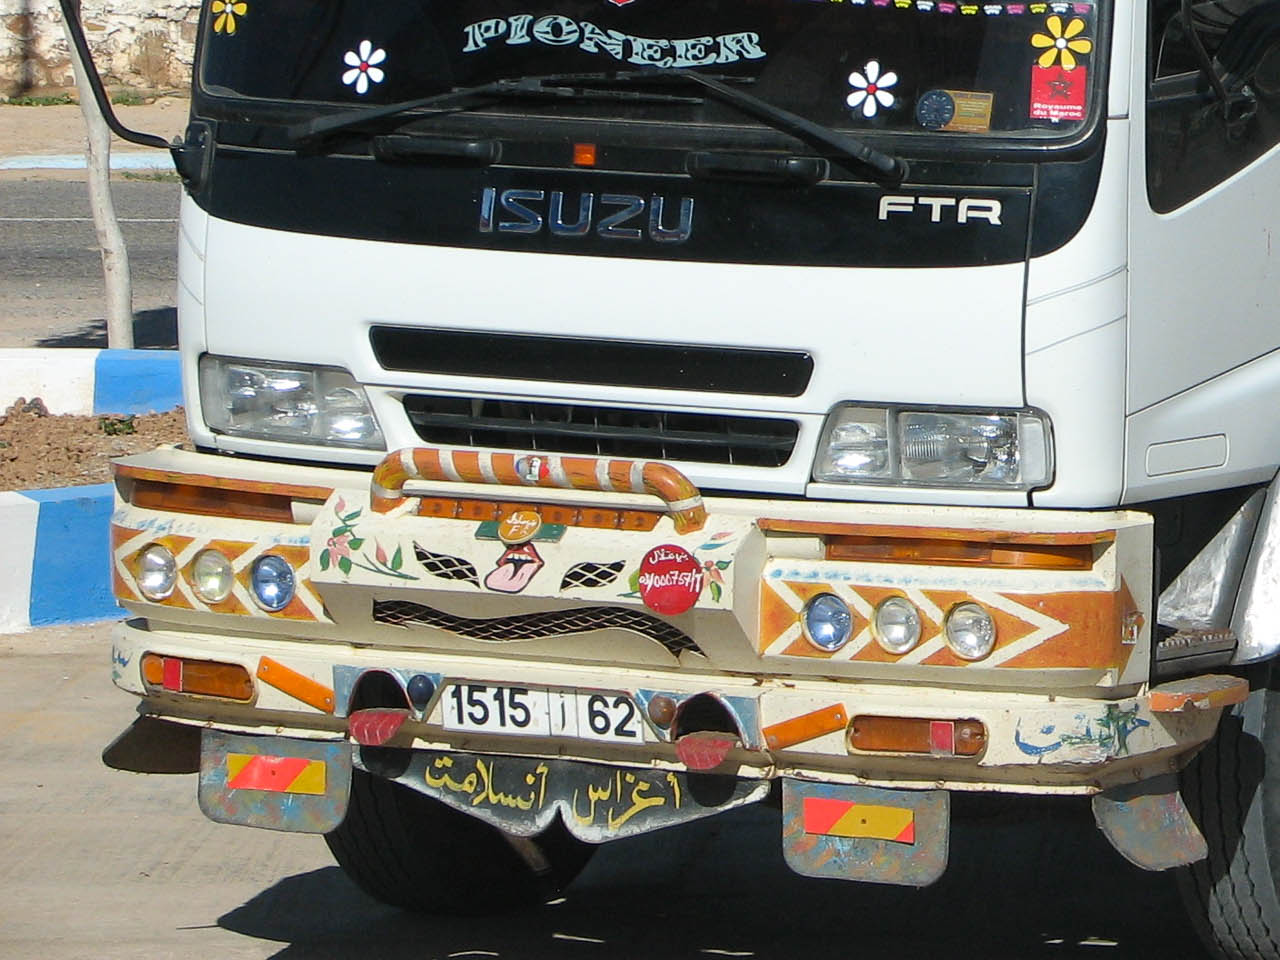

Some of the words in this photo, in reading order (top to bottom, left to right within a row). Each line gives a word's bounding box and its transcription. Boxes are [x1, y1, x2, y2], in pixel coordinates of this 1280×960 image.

[462, 14, 767, 69] PIONEER
[1033, 102, 1083, 111] Royaume
[1049, 109, 1082, 117] Maroc
[478, 187, 695, 244] ISUZU
[877, 195, 1003, 226] FTR
[450, 683, 531, 728] 1515
[588, 694, 637, 737] 62
